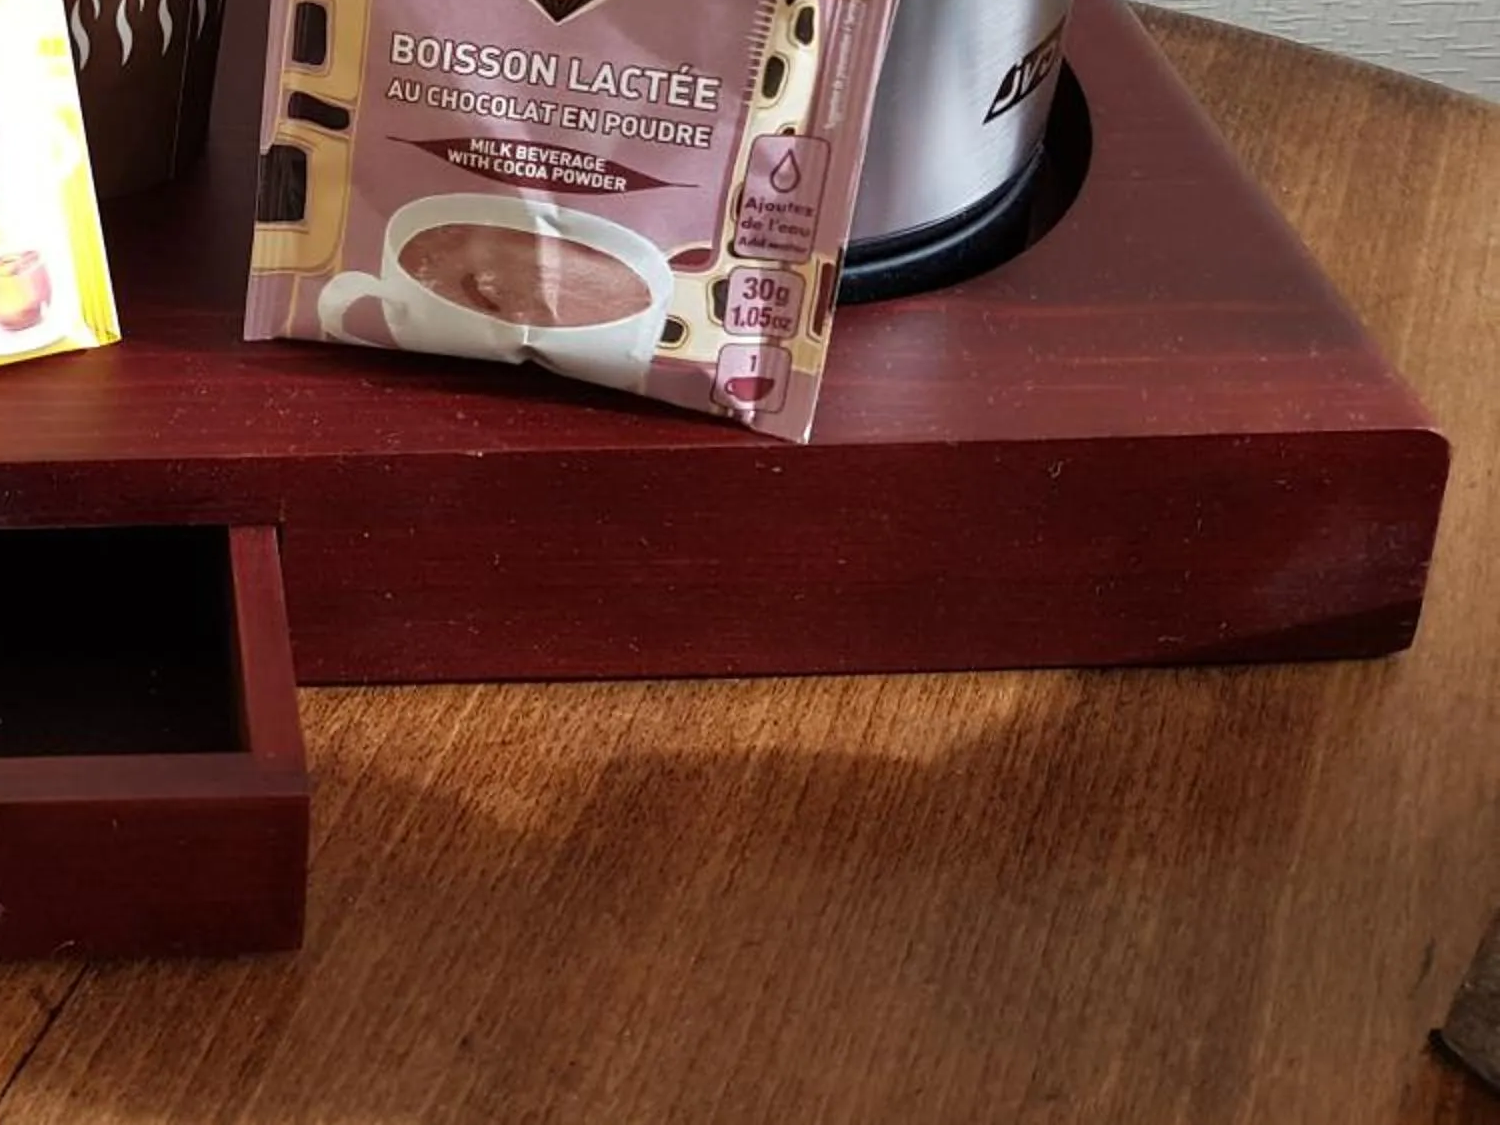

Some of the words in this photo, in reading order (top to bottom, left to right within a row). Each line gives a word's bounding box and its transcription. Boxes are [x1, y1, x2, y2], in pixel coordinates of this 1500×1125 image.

[391, 32, 558, 86] BOISSON
[568, 59, 721, 111] LACTÉE
[387, 80, 421, 102] AU
[427, 85, 557, 124] CHOCOLAT
[562, 106, 597, 131] EN
[604, 113, 712, 148] POUDRE
[448, 150, 490, 170] WITH
[493, 159, 547, 180] COCOA
[552, 167, 627, 192] POWDER
[470, 139, 512, 158] MILK
[516, 146, 606, 172] BEVERAGE
[741, 216, 763, 230] de
[743, 277, 790, 307] 30g
